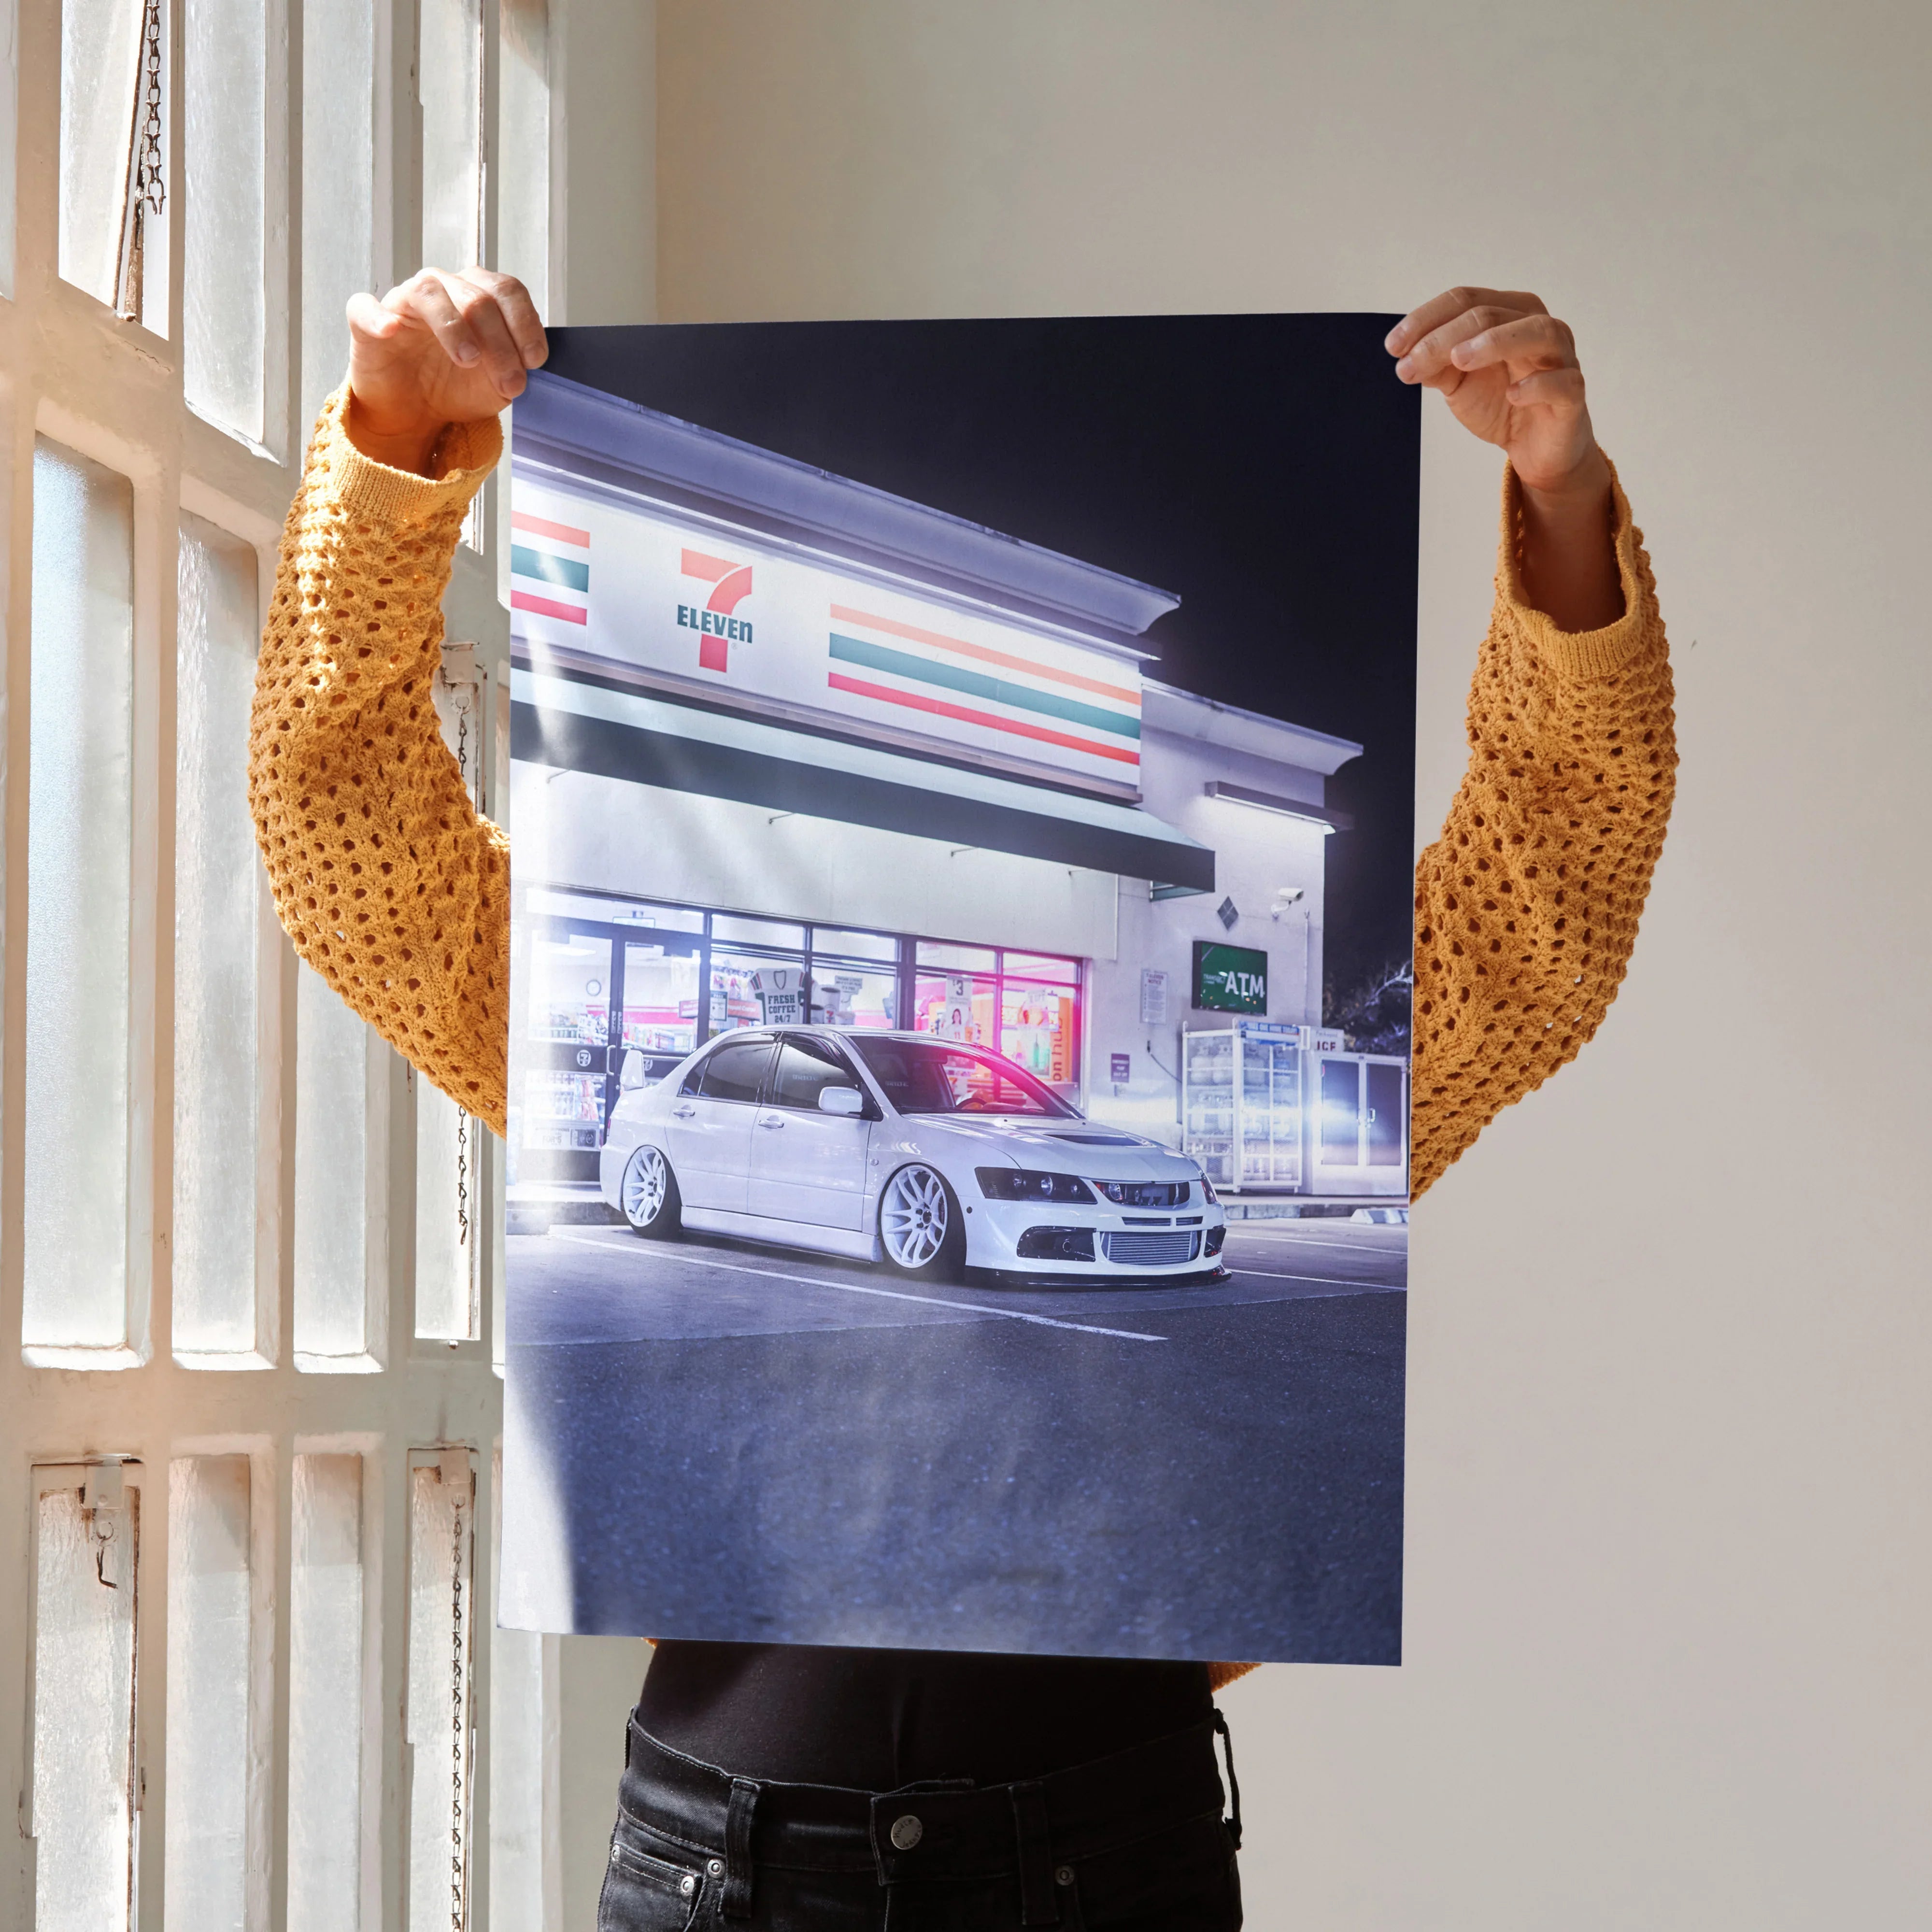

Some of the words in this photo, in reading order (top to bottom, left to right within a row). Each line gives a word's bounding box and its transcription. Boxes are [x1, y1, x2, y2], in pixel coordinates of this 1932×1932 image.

[681, 547, 753, 673] 7
[1225, 971, 1264, 998] ATM
[768, 994, 795, 1004] FRESH
[768, 1005, 796, 1014] COFFEE
[775, 1015, 790, 1023] 24/7
